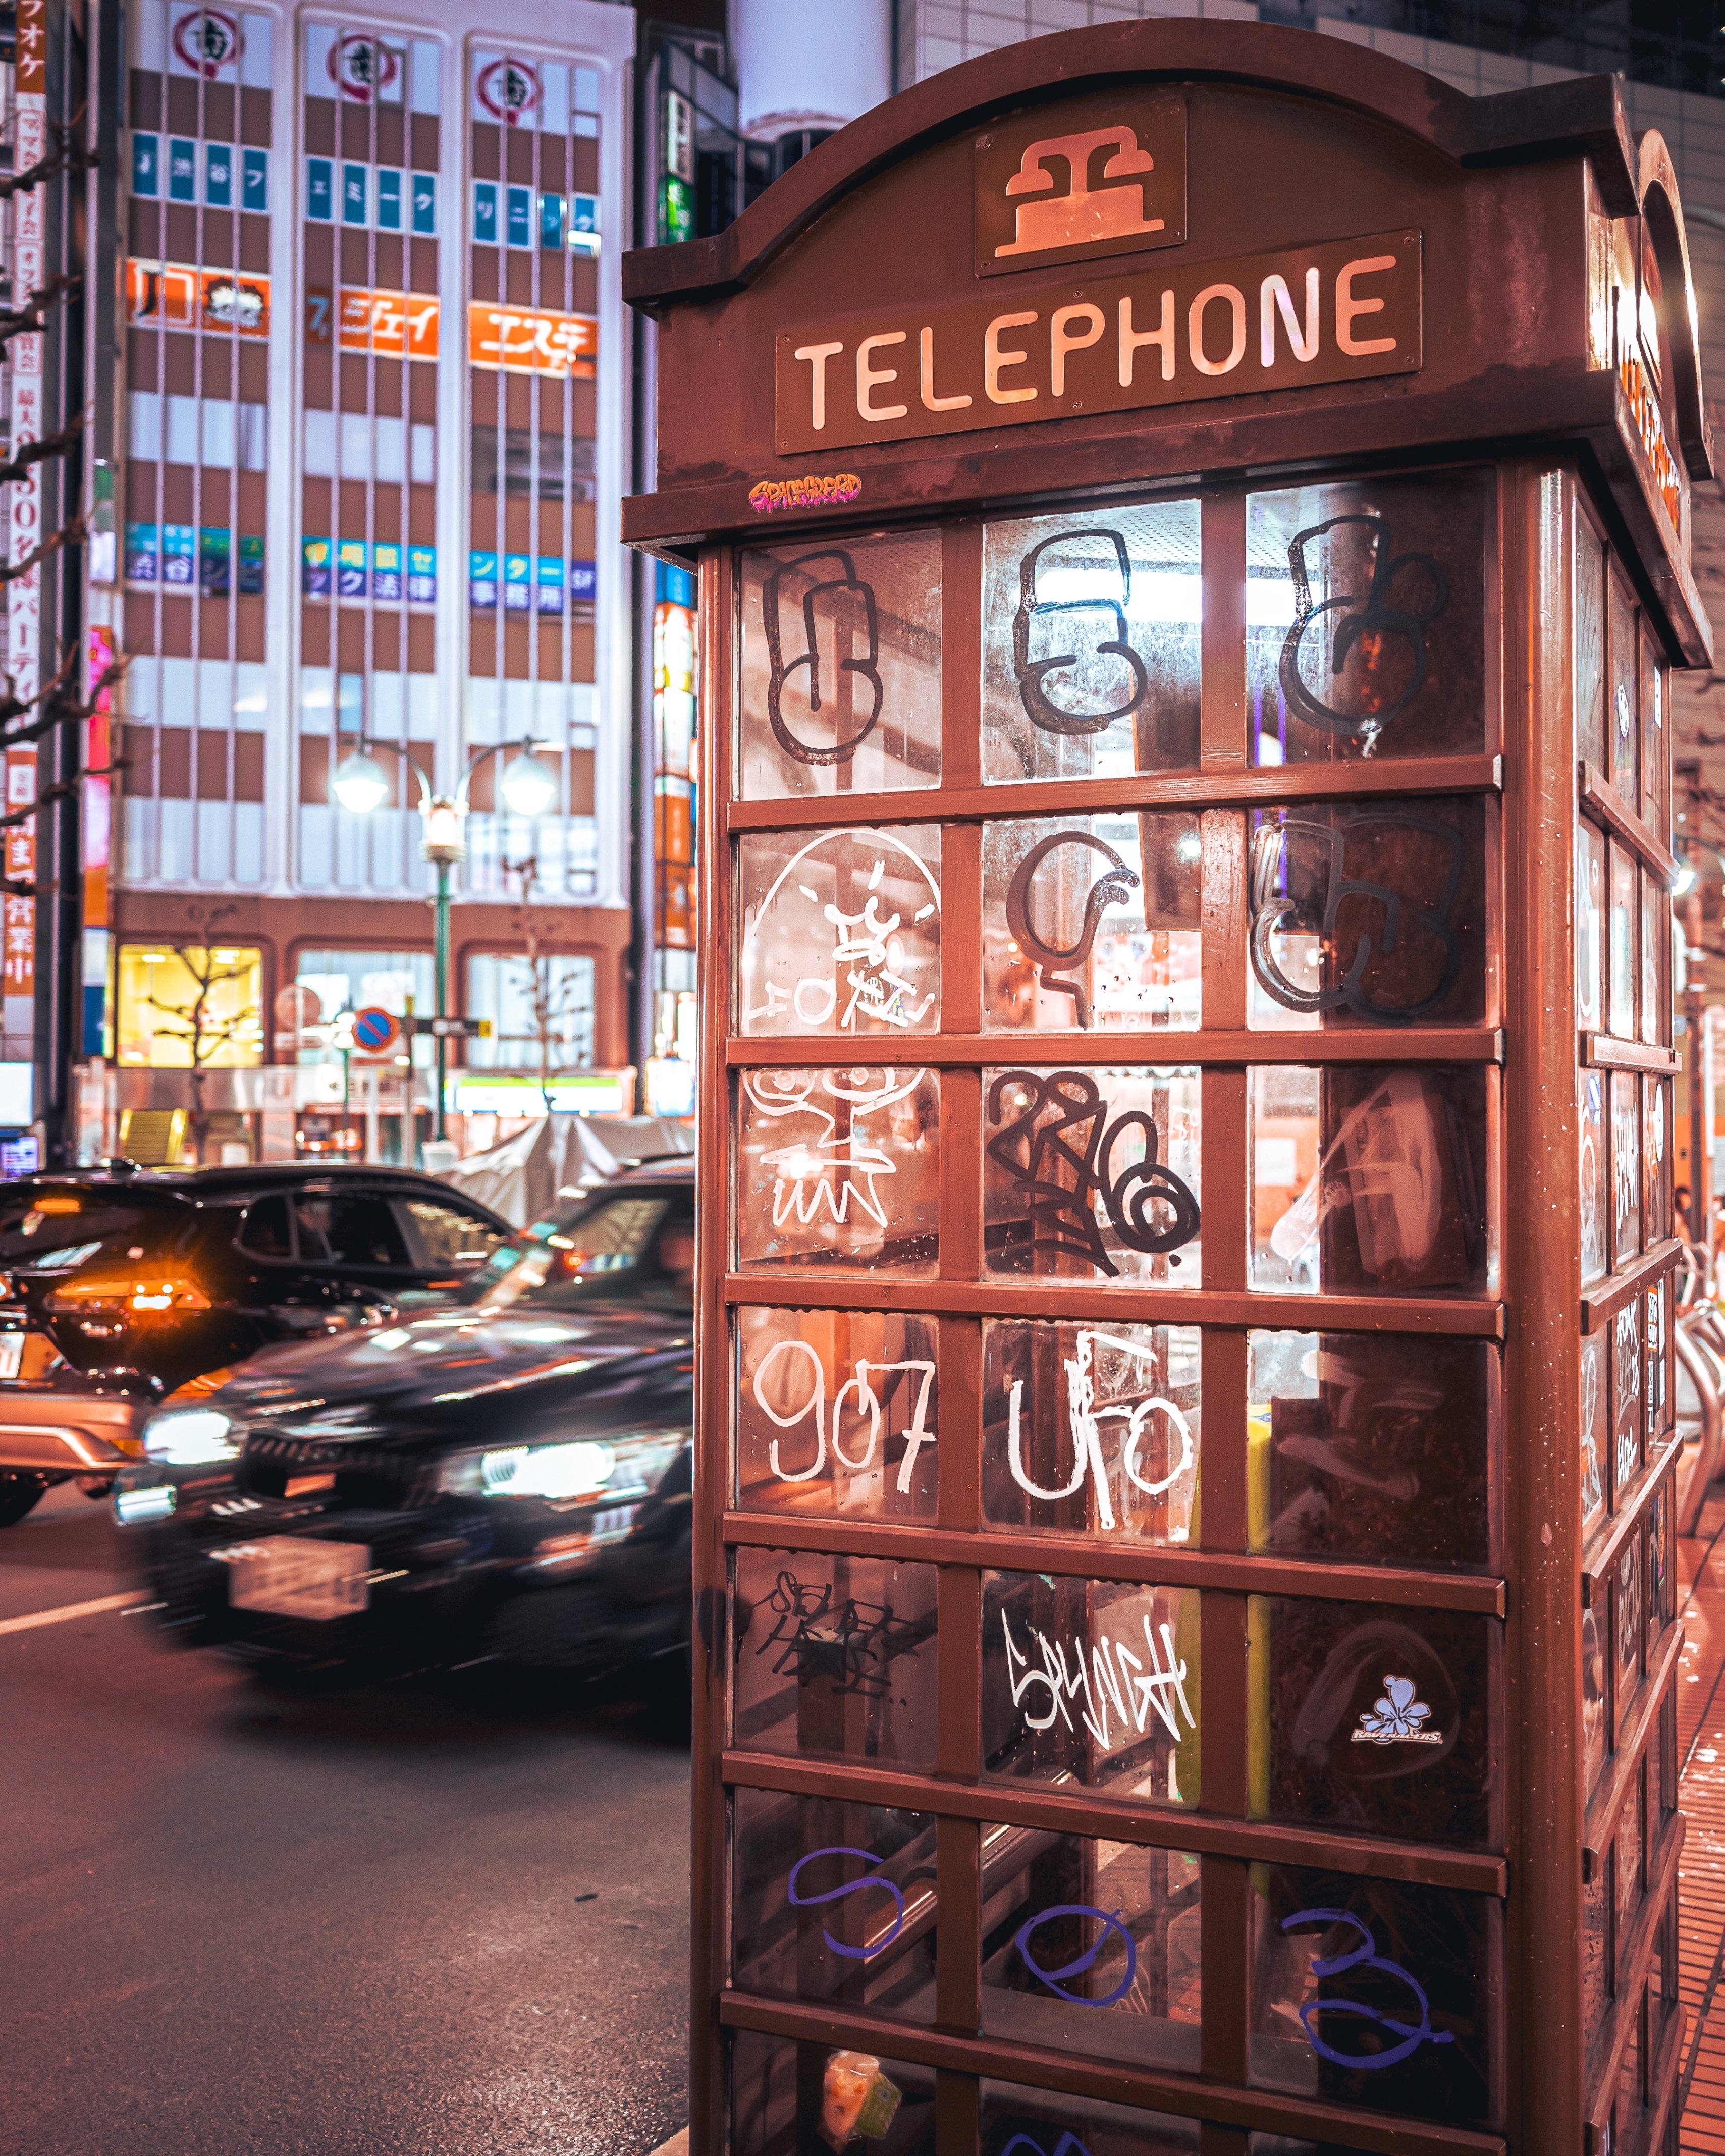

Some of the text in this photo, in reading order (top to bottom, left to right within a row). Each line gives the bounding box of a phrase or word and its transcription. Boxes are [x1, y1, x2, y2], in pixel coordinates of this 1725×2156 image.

[795, 255, 1396, 429] TELEPHONE
[754, 1341, 936, 1494] 907
[1353, 1730, 1440, 1742] RAVERACERS
